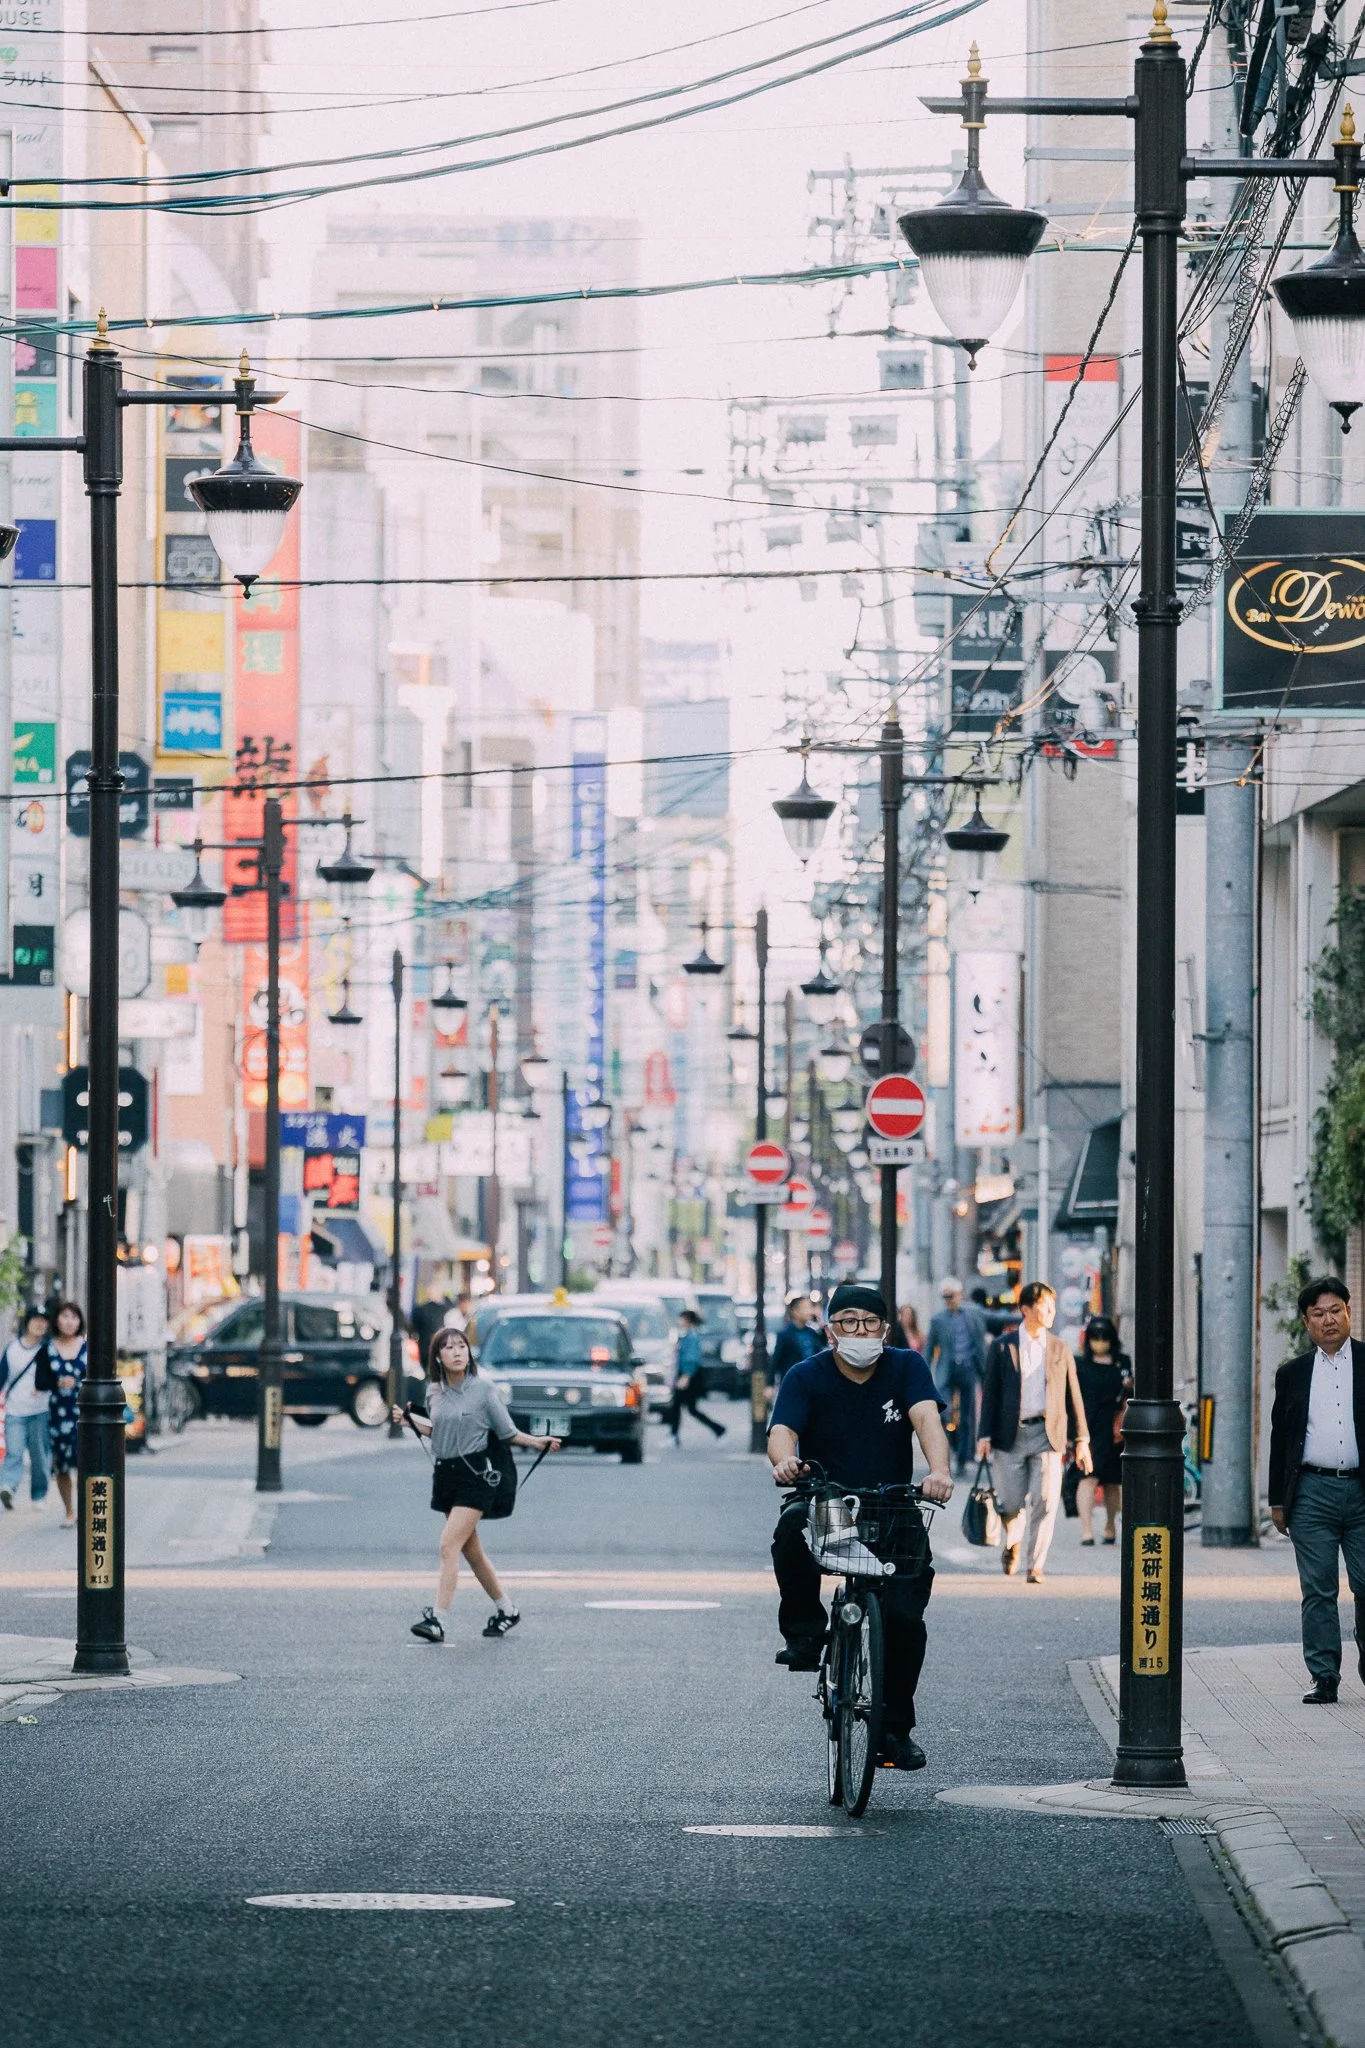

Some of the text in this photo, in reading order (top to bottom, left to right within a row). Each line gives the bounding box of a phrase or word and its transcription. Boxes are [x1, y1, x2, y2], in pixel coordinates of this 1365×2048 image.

[1140, 1533, 1163, 1650] 薬研堀通り
[1139, 1657, 1163, 1668] 西15
